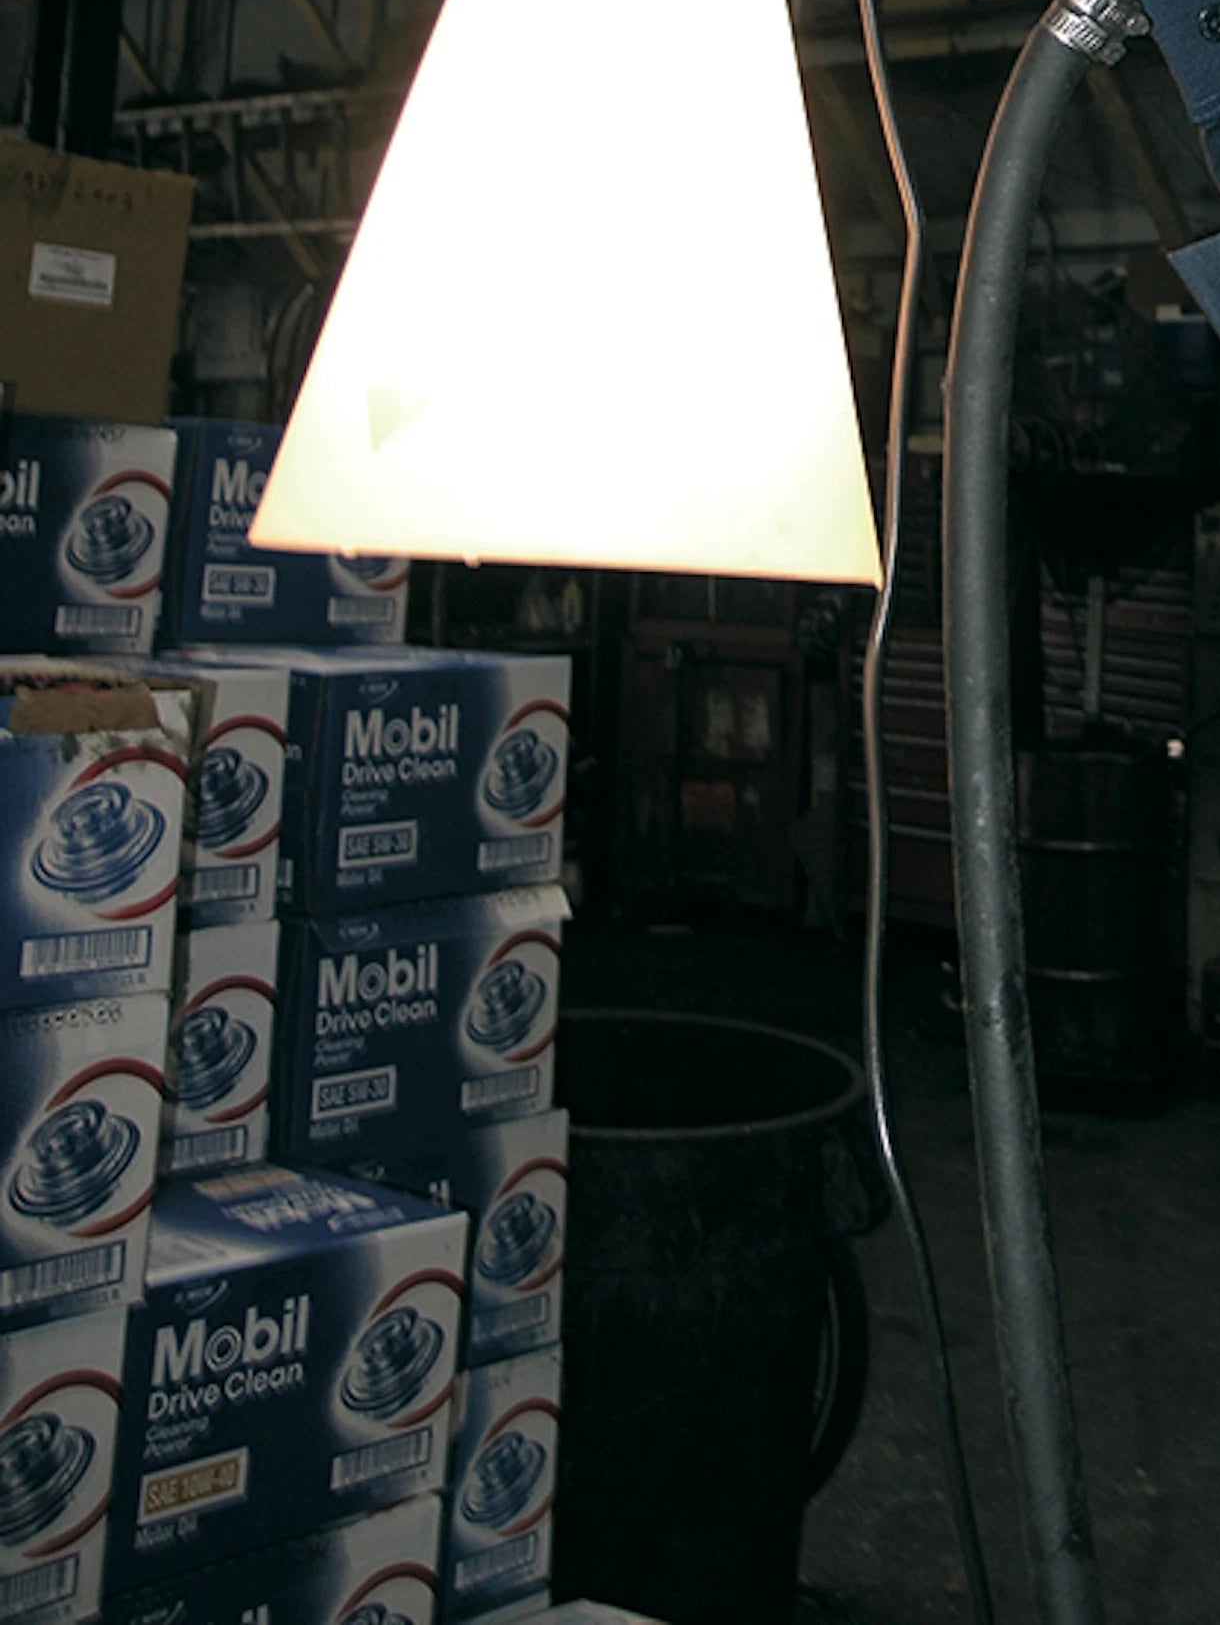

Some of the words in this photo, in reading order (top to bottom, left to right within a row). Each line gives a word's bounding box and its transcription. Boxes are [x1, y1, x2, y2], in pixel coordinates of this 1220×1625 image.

[344, 703, 459, 758] Mobil
[342, 760, 396, 785] Drive
[398, 756, 457, 781] Clean
[317, 942, 438, 1008] Mobil
[315, 1007, 372, 1036] Drive
[374, 999, 439, 1028] Clean
[151, 1293, 310, 1387] Mobil
[147, 1381, 221, 1422] Drive
[223, 1361, 304, 1401] Clean
